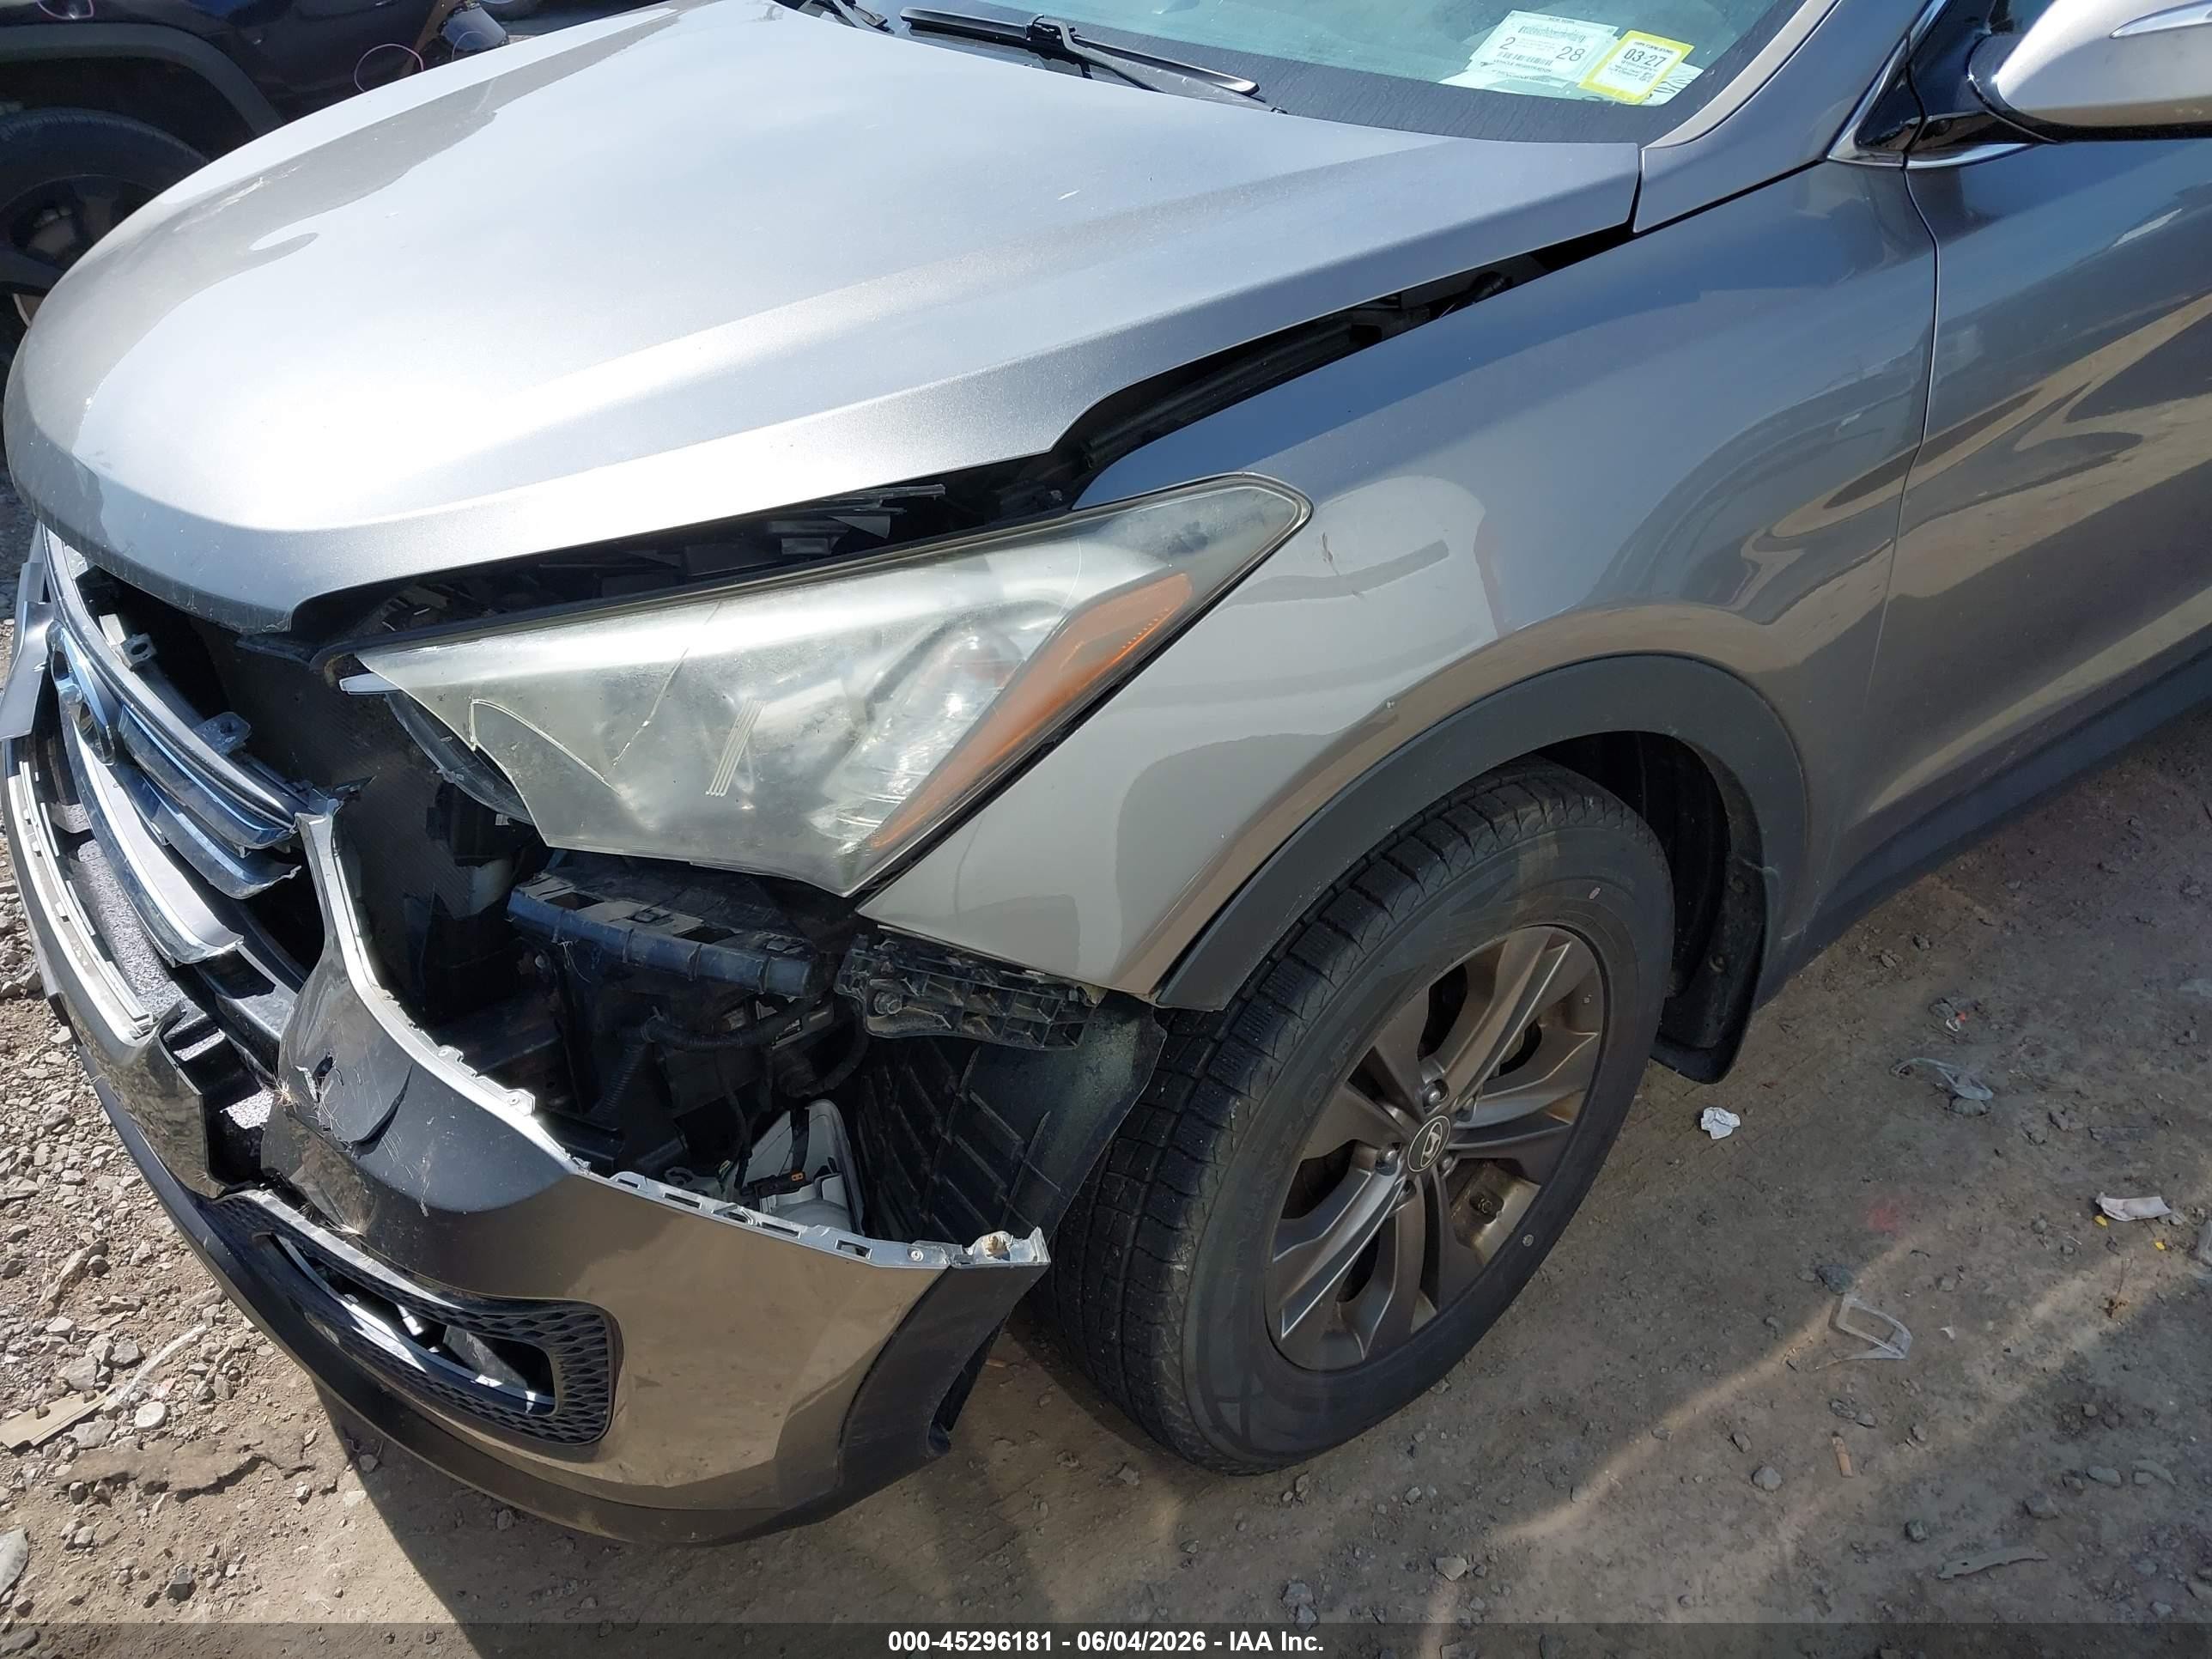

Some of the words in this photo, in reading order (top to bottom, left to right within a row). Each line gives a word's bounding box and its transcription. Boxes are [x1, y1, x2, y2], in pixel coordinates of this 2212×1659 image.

[1499, 36, 1516, 50] 2
[1555, 46, 1586, 62] 28
[1624, 48, 1668, 68] 03-27
